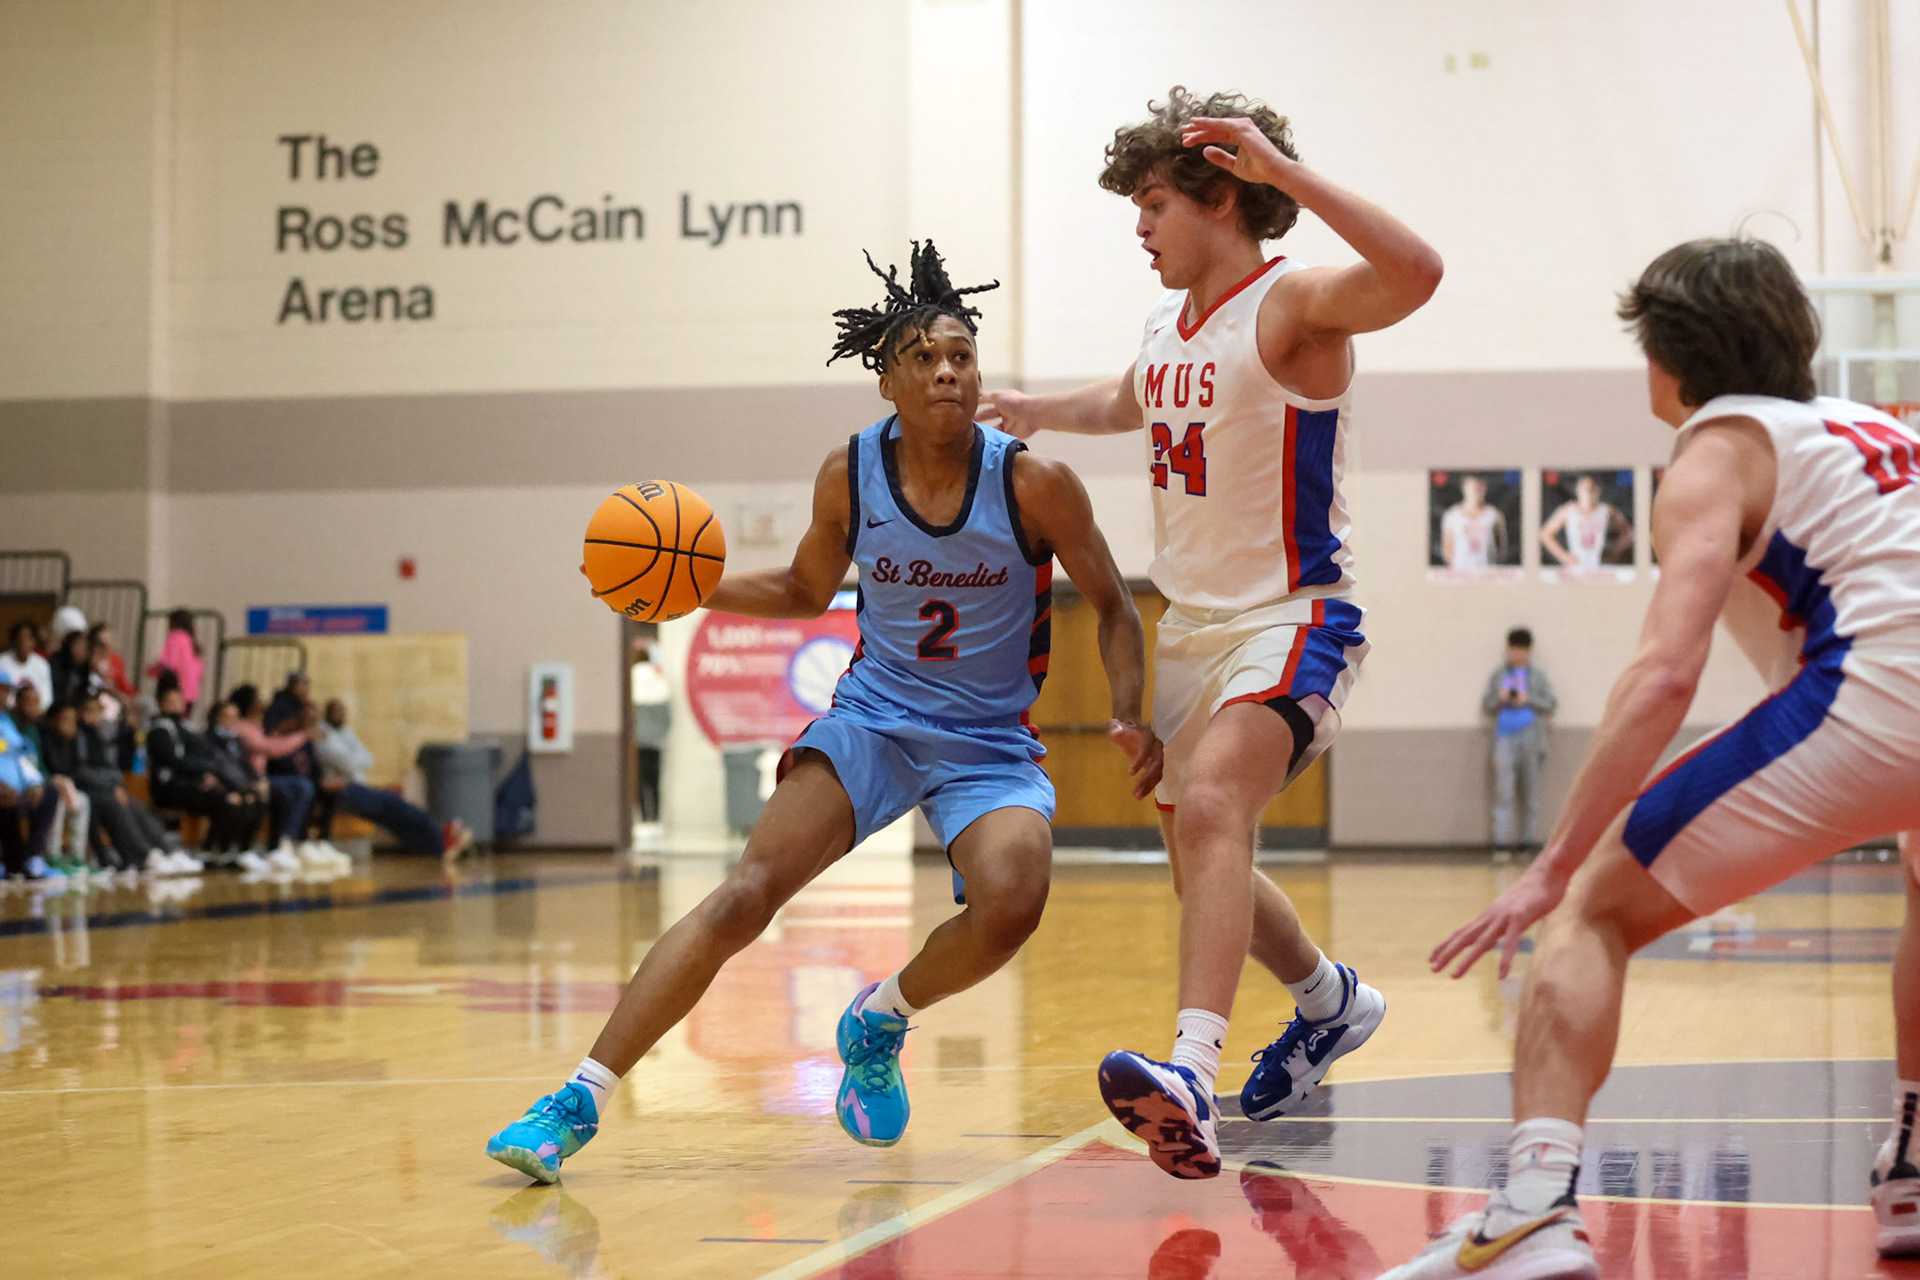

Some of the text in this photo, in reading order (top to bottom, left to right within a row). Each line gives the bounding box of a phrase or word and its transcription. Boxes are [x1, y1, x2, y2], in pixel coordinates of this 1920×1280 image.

[279, 135, 380, 181] The
[276, 193, 803, 253] Ross McCain Lynn
[277, 277, 435, 325] Arena
[1145, 362, 1216, 408] MUS
[1150, 422, 1207, 497] 24
[871, 557, 1009, 588] St Benedict
[916, 598, 960, 661] 2
